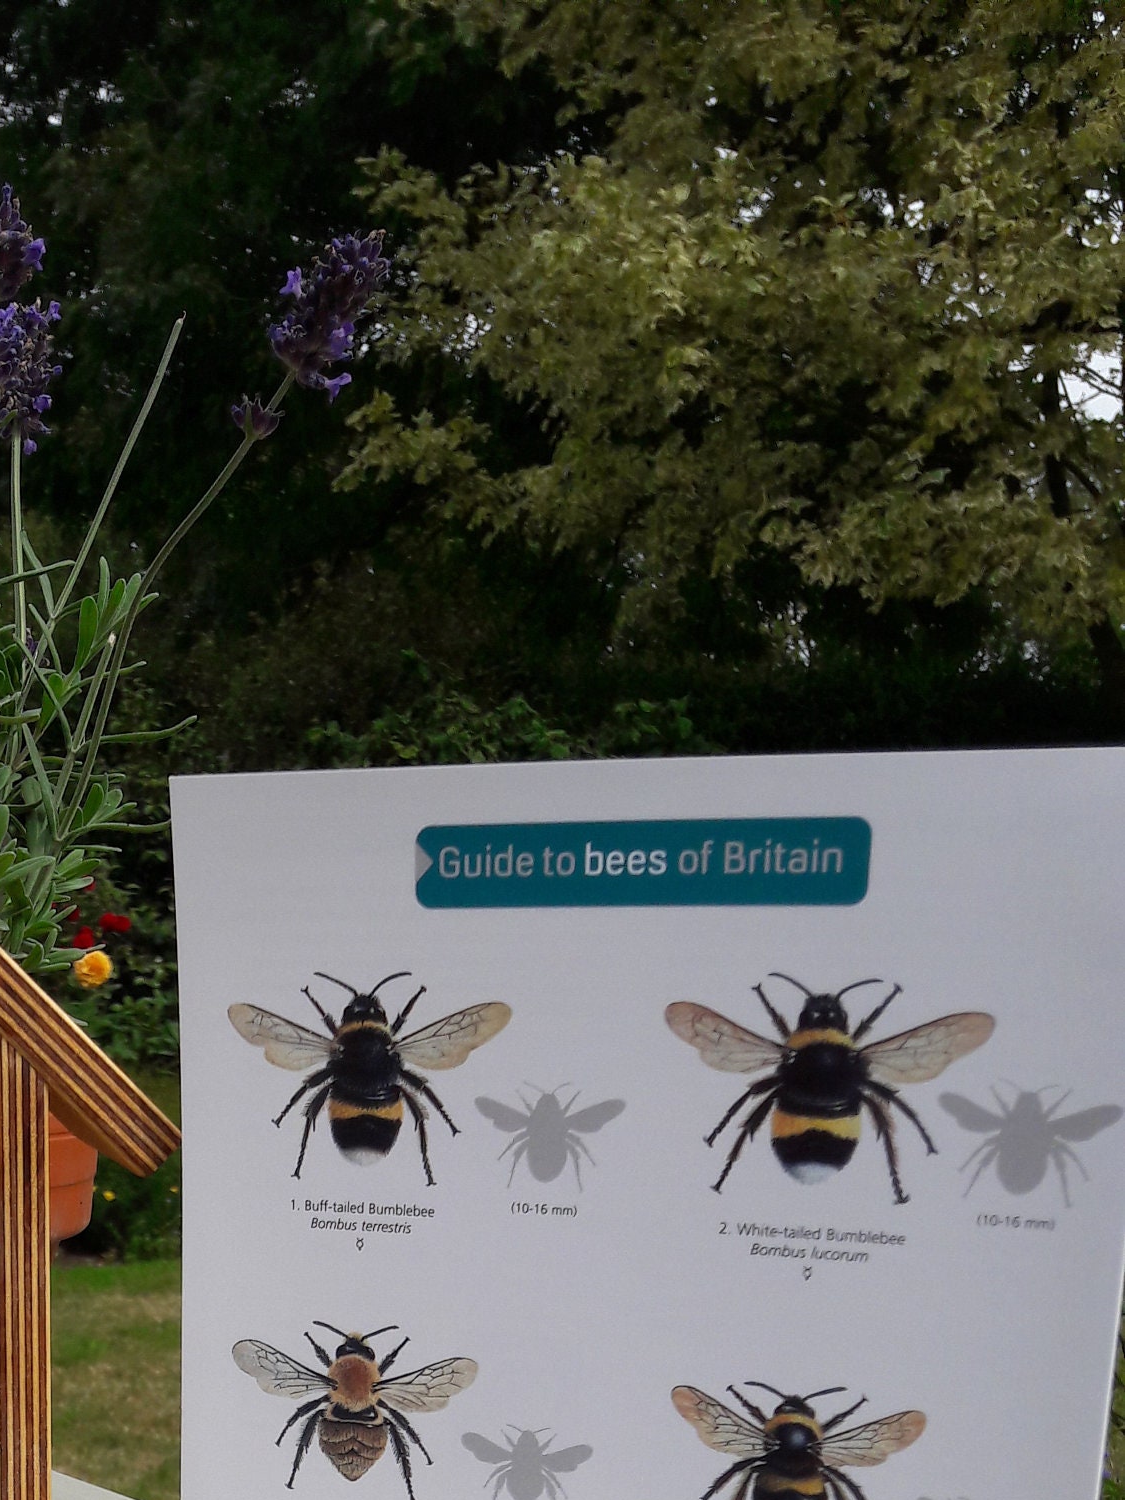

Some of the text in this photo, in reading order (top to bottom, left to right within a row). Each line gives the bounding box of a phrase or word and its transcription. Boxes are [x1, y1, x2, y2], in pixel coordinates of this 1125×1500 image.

[438, 839, 844, 879] Guide to bees of Britain
[290, 1199, 435, 1218] 1. Buff-tailed Bumblebee
[511, 1202, 577, 1217] (10-16 mm)
[310, 1217, 412, 1234] Bombus terrestris
[976, 1214, 1056, 1231] (10-16 mm)
[719, 1222, 906, 1245] 2. White-tailed Bumblebee
[750, 1243, 869, 1263] Bombus lucorum
